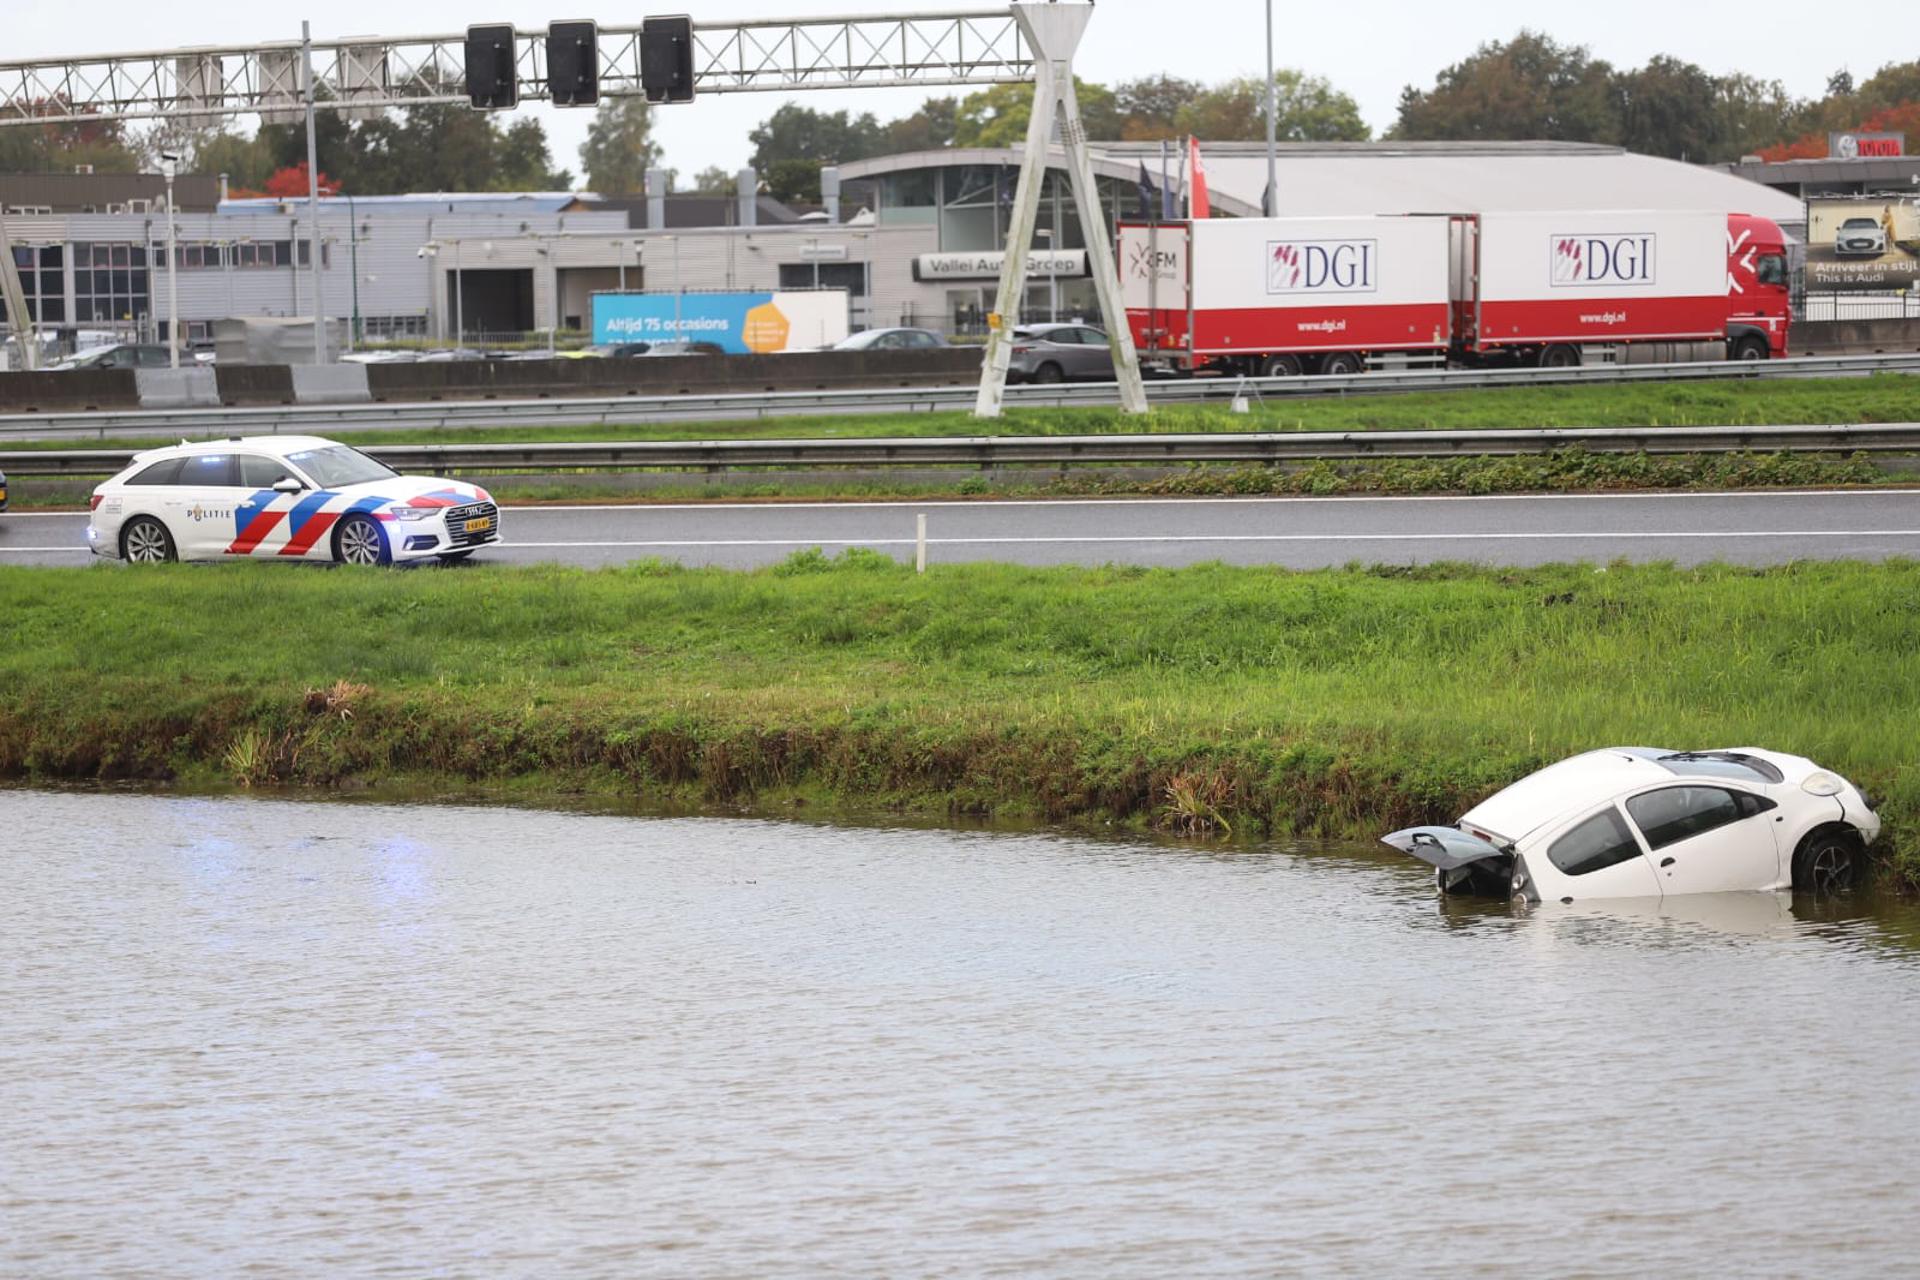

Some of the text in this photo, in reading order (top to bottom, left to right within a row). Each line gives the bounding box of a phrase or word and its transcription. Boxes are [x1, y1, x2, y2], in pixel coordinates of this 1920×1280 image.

[1858, 138, 1902, 156] TOYOTA
[930, 259, 973, 273] Vallei
[1304, 244, 1371, 288] DGI
[1586, 238, 1649, 281] DGI
[1815, 260, 1919, 273] Arriveer in stijl
[1815, 273, 1884, 282] This is Audi
[606, 316, 729, 334] Altijd 75 occasions
[1580, 311, 1627, 325] www.dgi.nl
[1297, 319, 1346, 333] www.dgi.nl
[187, 509, 231, 521] POLITIE
